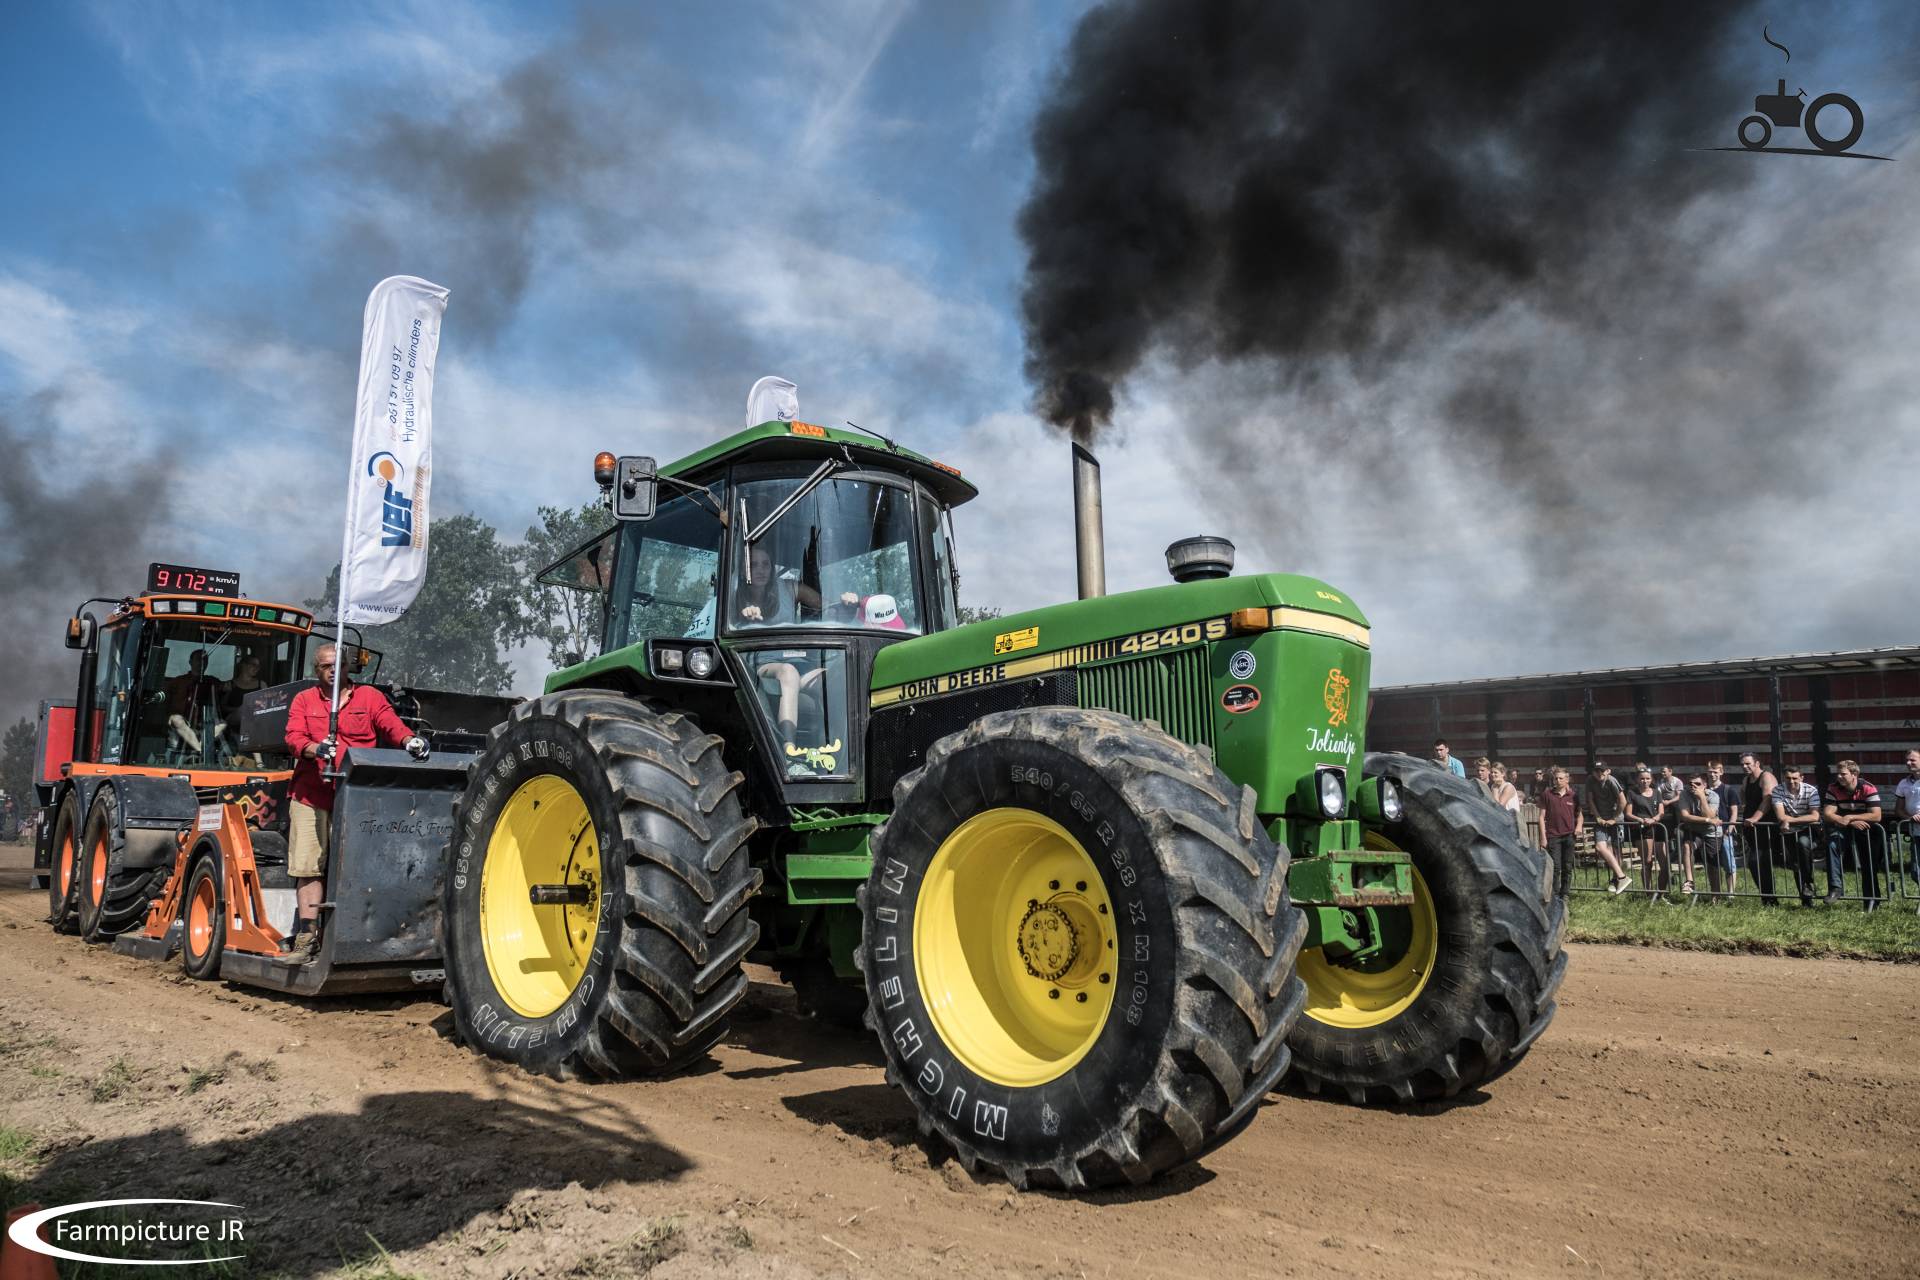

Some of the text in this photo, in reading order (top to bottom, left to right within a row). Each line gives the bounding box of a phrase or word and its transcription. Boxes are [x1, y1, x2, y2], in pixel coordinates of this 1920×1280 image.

[393, 345, 403, 361] 97
[402, 318, 422, 442] Hydraulische cilinders
[215, 576, 238, 585] km/u
[898, 664, 1006, 700] JOHN DEERE
[1329, 668, 1350, 687] Goe
[1328, 707, 1348, 727] Zot
[386, 820, 425, 838] Black
[471, 893, 612, 1049] MICHELIN
[876, 858, 1007, 1140] MICHELIN
